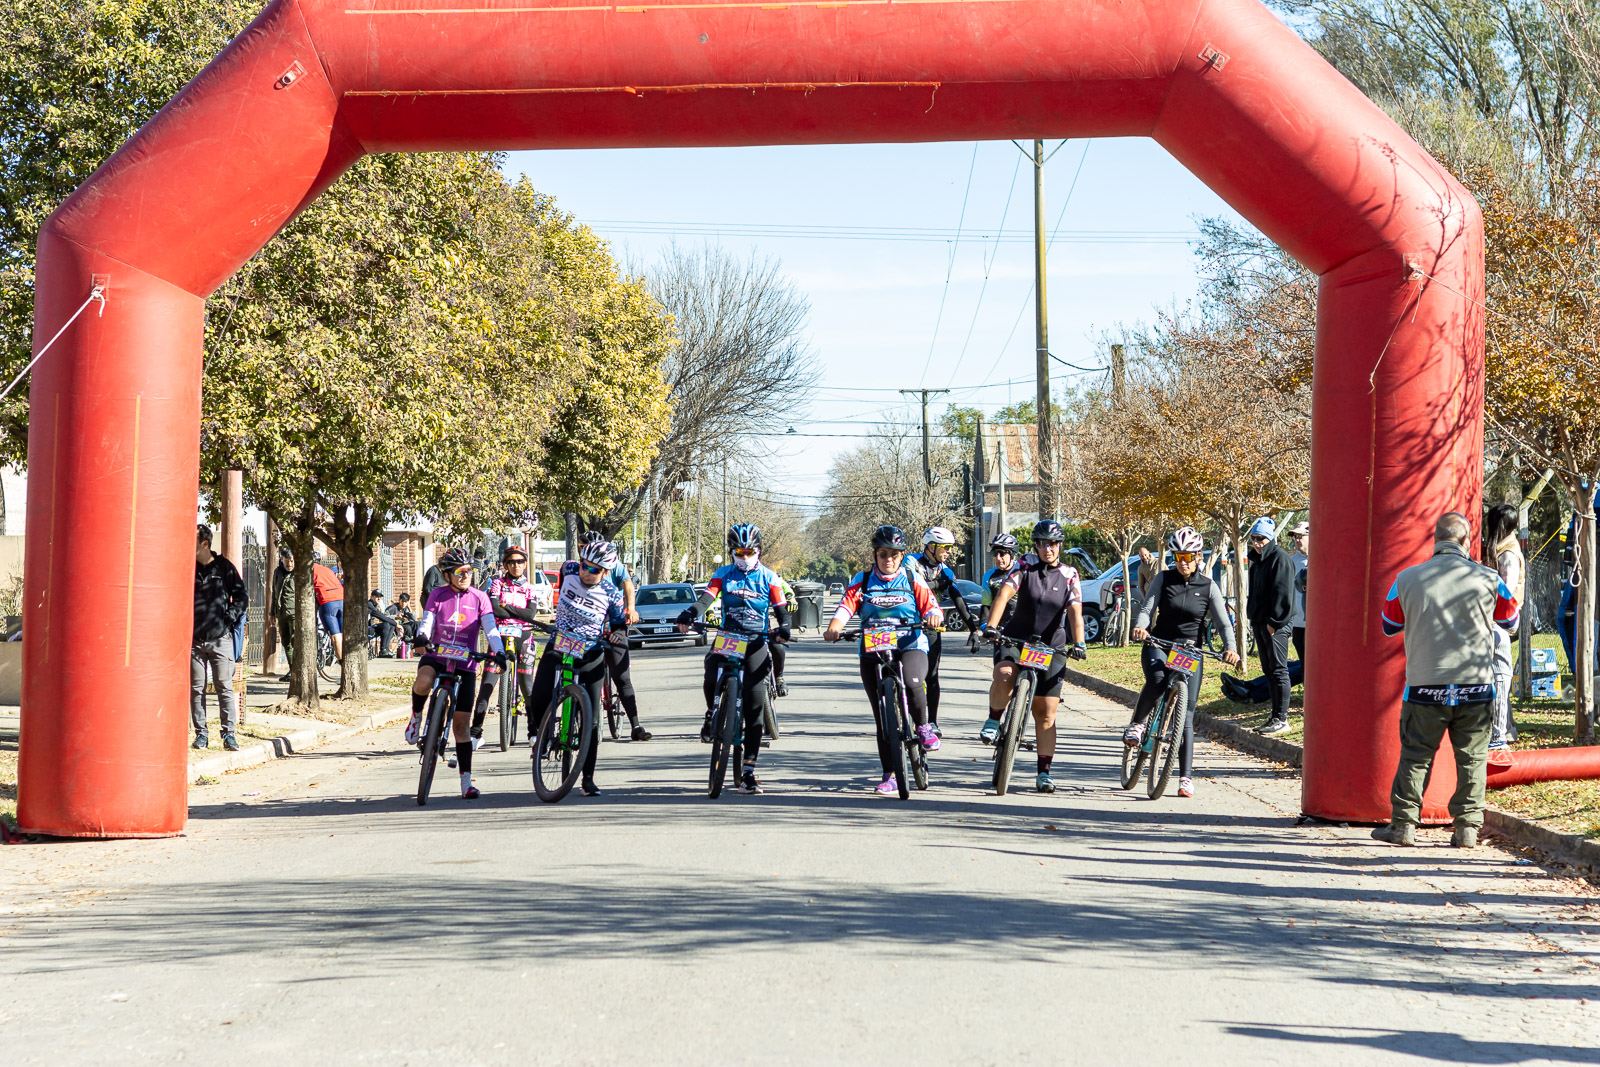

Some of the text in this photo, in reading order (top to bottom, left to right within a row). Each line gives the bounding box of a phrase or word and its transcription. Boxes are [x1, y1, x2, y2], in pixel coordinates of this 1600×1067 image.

[722, 637, 740, 651] 15
[871, 632, 891, 645] 46
[1026, 650, 1048, 664] 115
[1172, 653, 1195, 670] 86
[1417, 684, 1489, 696] PROTECH
